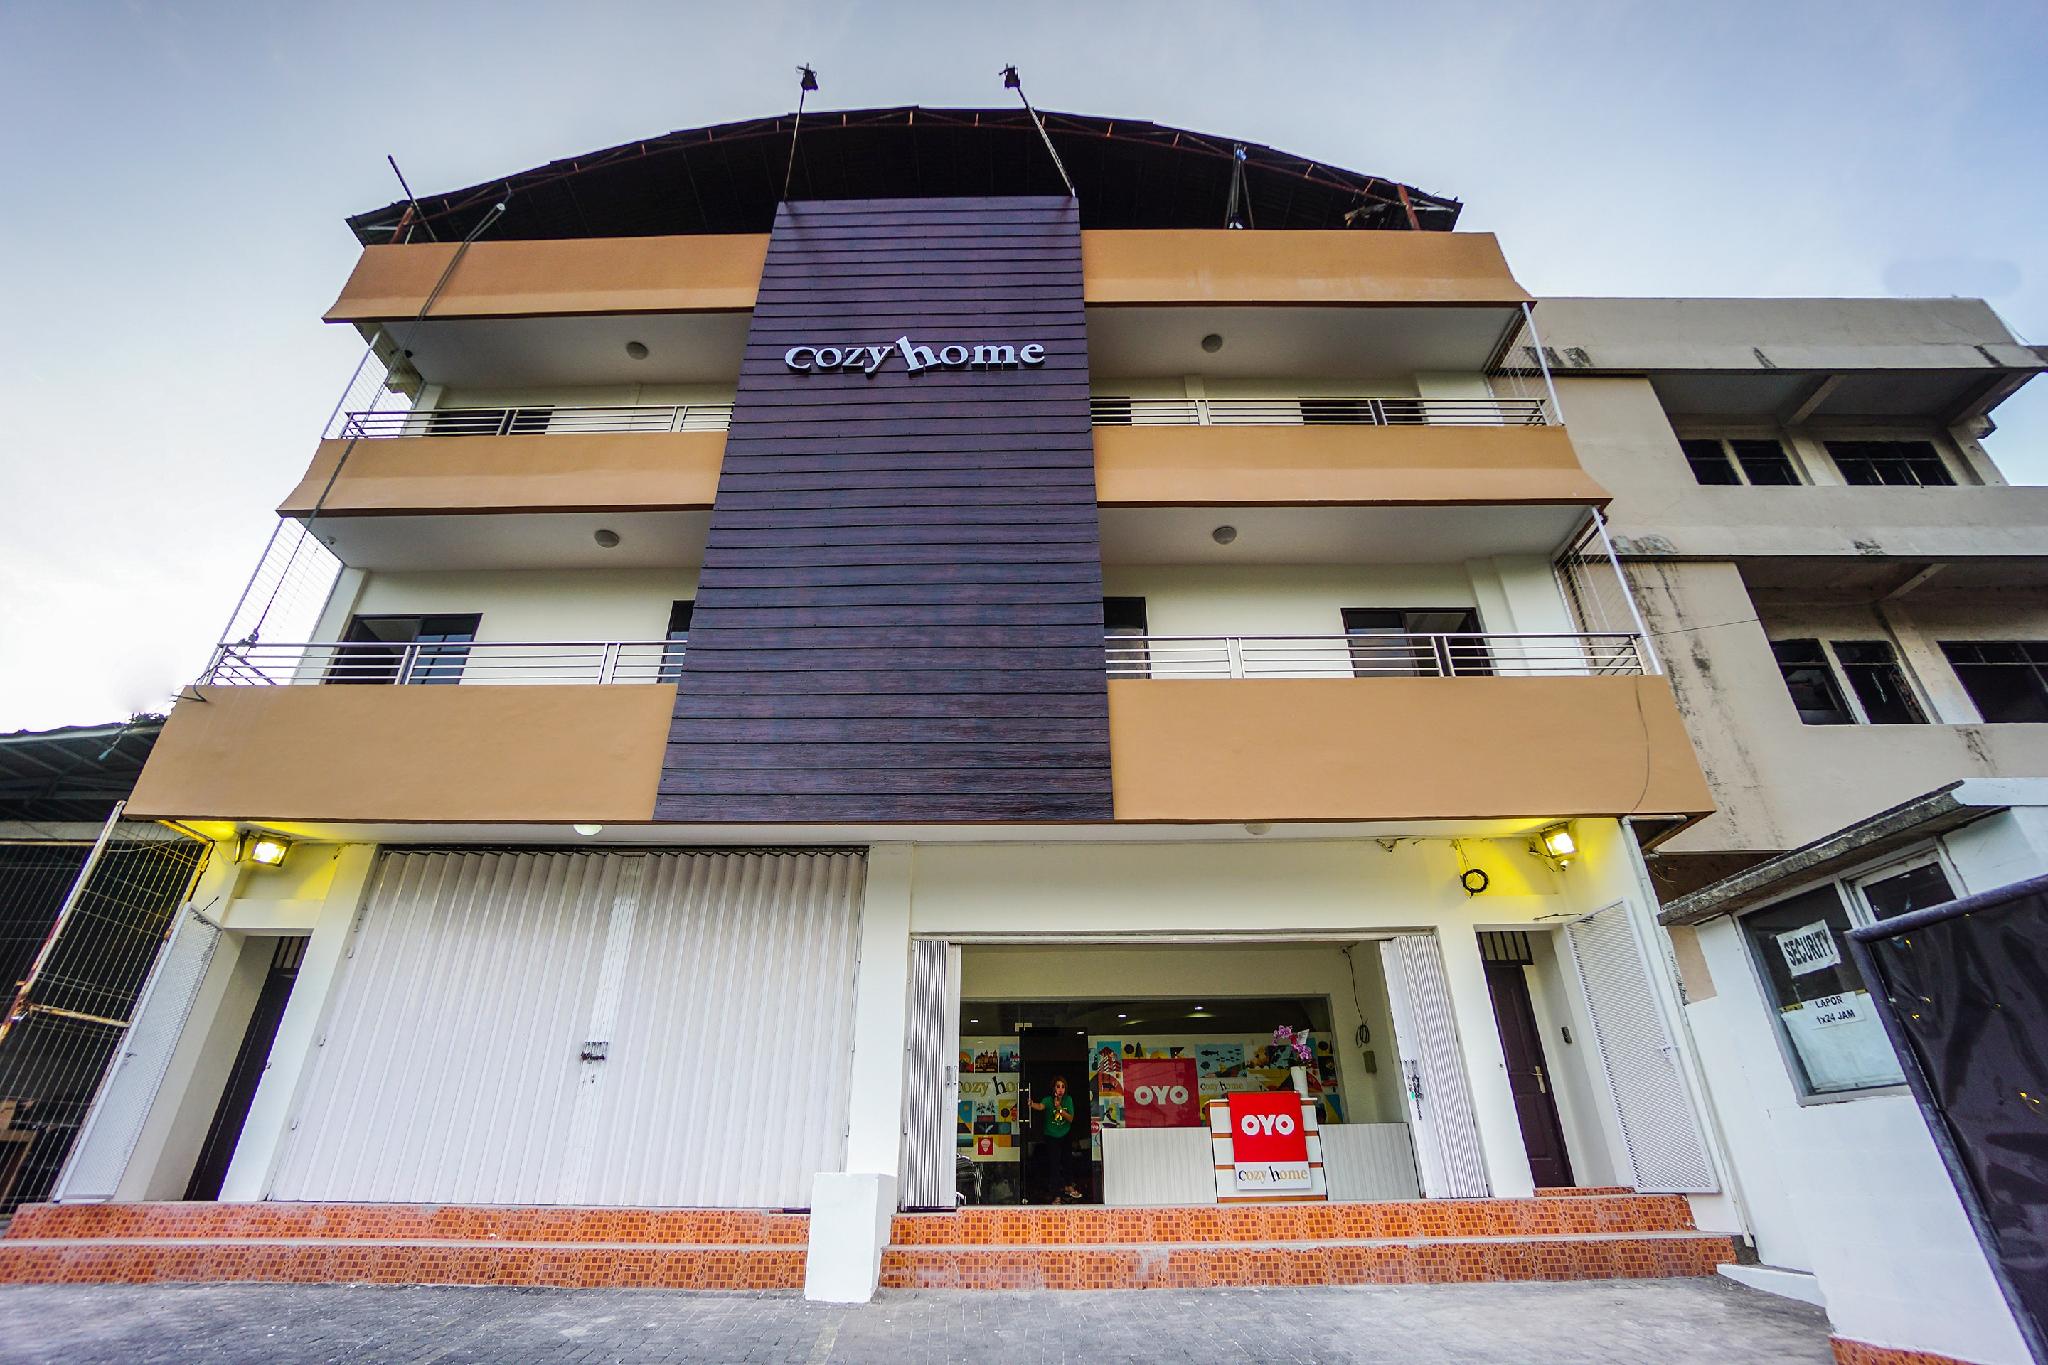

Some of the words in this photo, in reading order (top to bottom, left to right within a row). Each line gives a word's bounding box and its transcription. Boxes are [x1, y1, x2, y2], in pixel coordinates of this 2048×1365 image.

[1783, 929, 1834, 967] SECURITY
[1815, 994, 1843, 1009] LAPOR
[1816, 1012, 1836, 1025] 1x24
[1837, 1009, 1856, 1021] JAM
[958, 1081, 989, 1097] ozy
[1133, 1085, 1189, 1106] OYO
[1241, 1114, 1295, 1136] OYO
[1238, 1169, 1267, 1184] cozy
[1268, 1165, 1308, 1182] home
